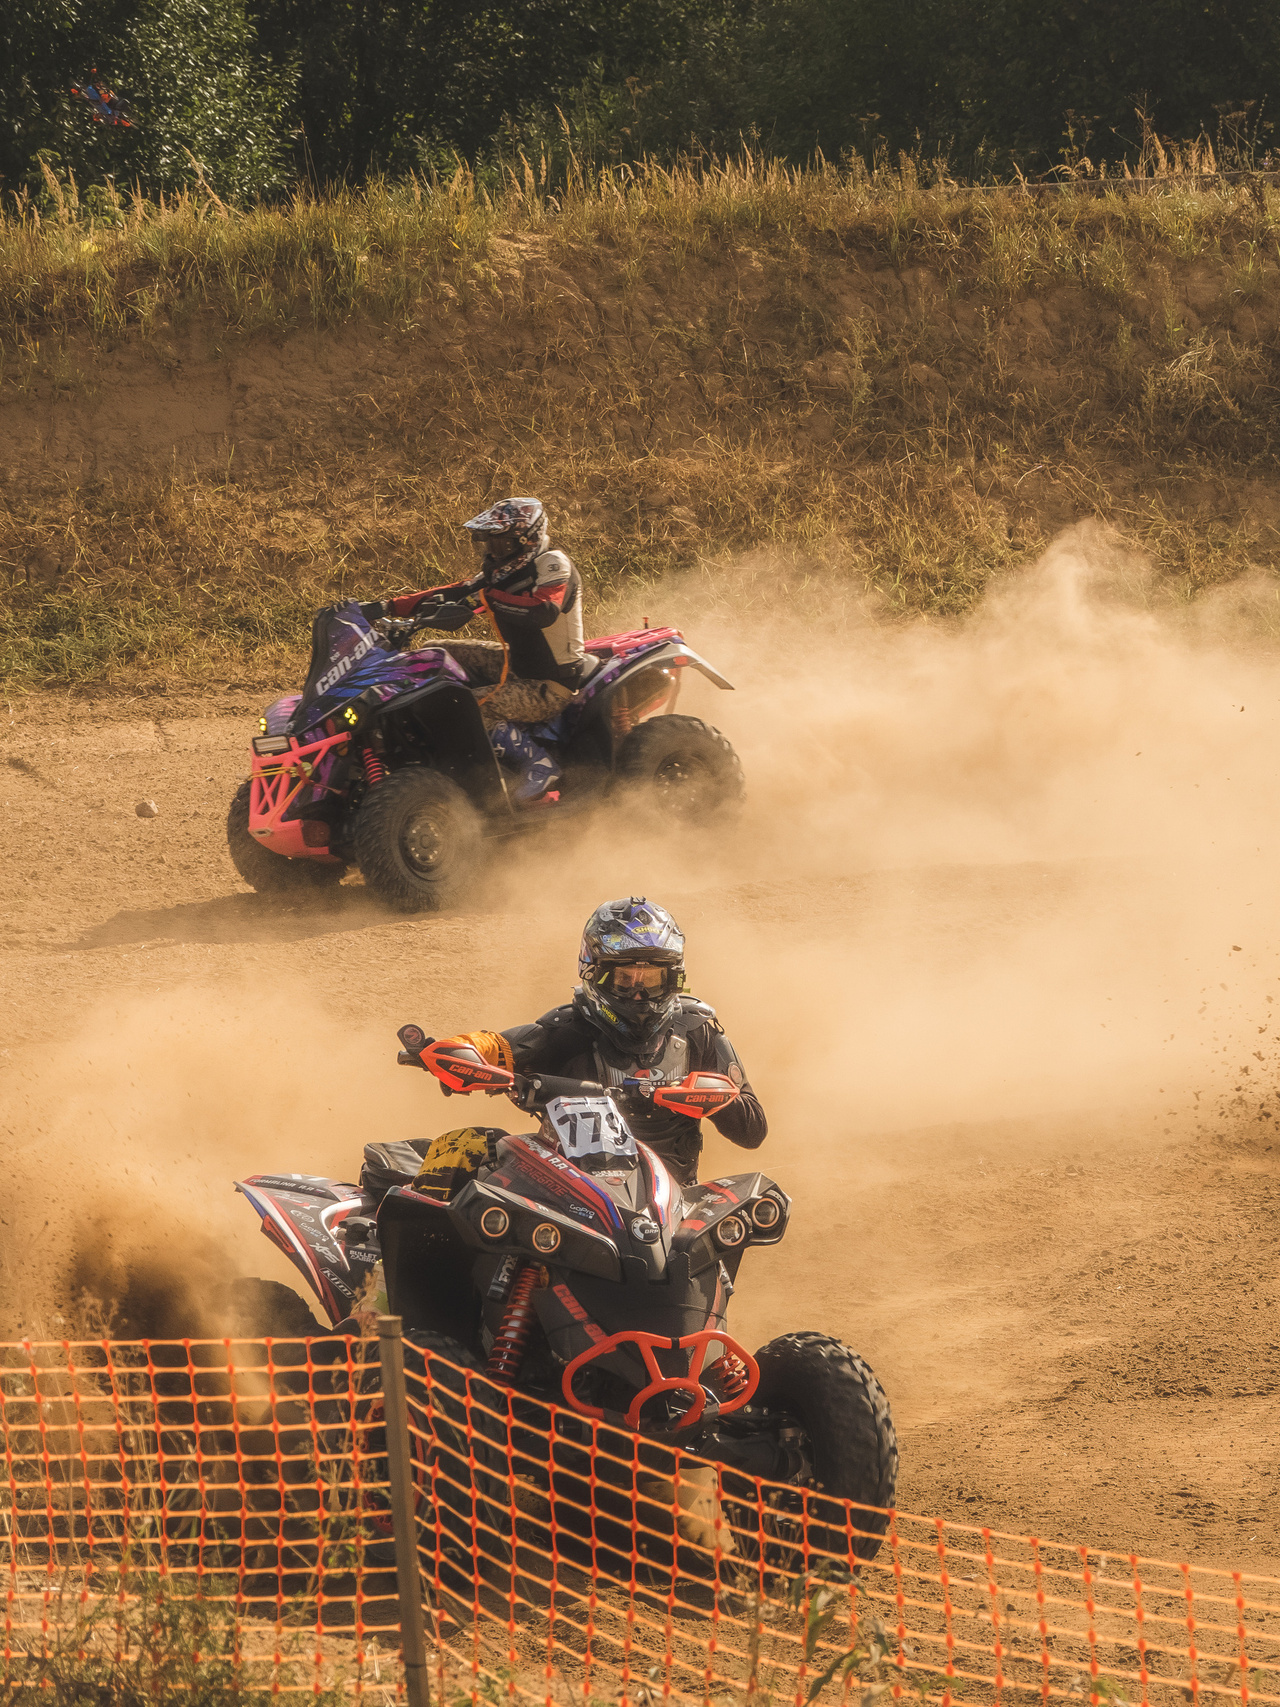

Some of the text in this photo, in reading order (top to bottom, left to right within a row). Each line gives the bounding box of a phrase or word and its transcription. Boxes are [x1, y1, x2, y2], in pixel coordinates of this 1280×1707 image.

[448, 1063, 493, 1081] can-am
[685, 1094, 724, 1103] can-am
[569, 1203, 595, 1216] GoPro
[349, 1250, 378, 1260] BULLET
[498, 1254, 519, 1283] FOX
